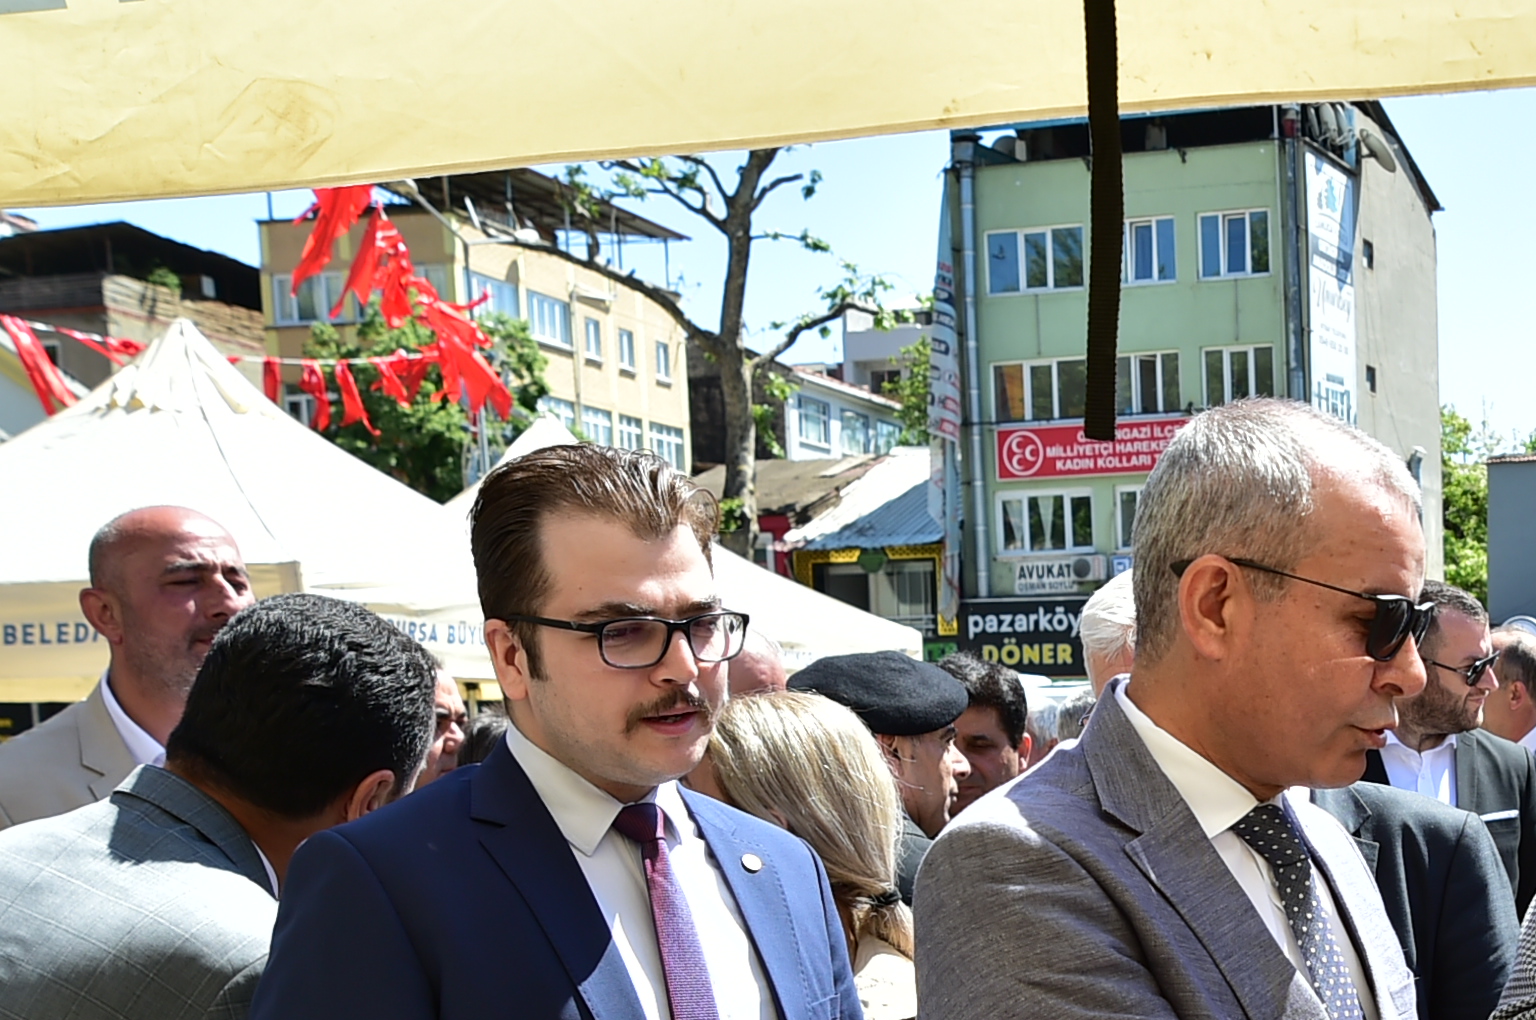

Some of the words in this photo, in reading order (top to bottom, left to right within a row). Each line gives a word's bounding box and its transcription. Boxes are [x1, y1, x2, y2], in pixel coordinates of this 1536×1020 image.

[1046, 441, 1113, 458] MİLLİYETÇİ
[1056, 458, 1094, 471] KADIN
[1097, 454, 1151, 470] KOLLARI
[1018, 563, 1071, 580] AVUKAT
[968, 606, 1080, 640] pazarköy
[982, 637, 1073, 665] DÖNER
